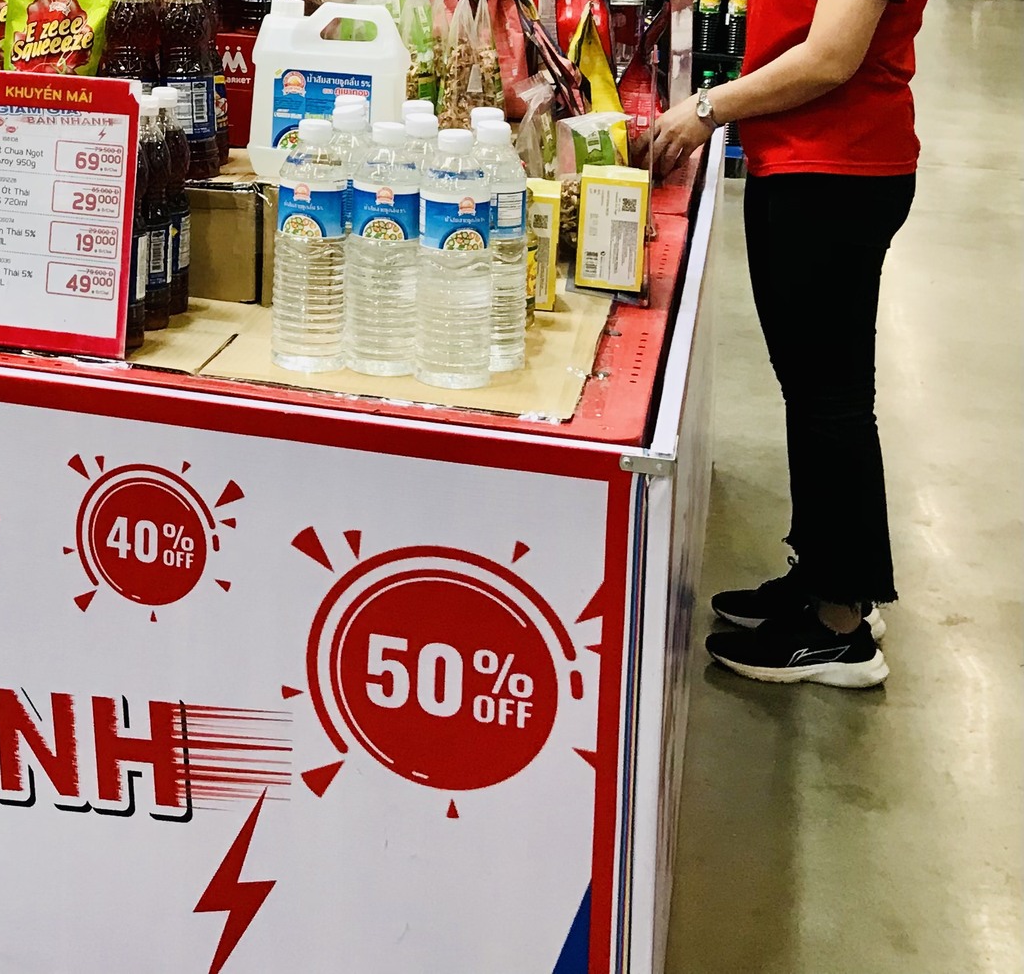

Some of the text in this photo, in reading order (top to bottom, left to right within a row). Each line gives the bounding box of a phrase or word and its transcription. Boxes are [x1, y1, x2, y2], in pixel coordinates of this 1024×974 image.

[41, 17, 82, 39] zeee
[5, 83, 93, 103] KHUYẾN MÃI
[4, 147, 23, 155] Chua
[16, 158, 36, 169] 950g
[4, 197, 28, 206] 720ml
[163, 548, 195, 570] OFF
[364, 633, 535, 718] 50%
[472, 695, 534, 729] OFF
